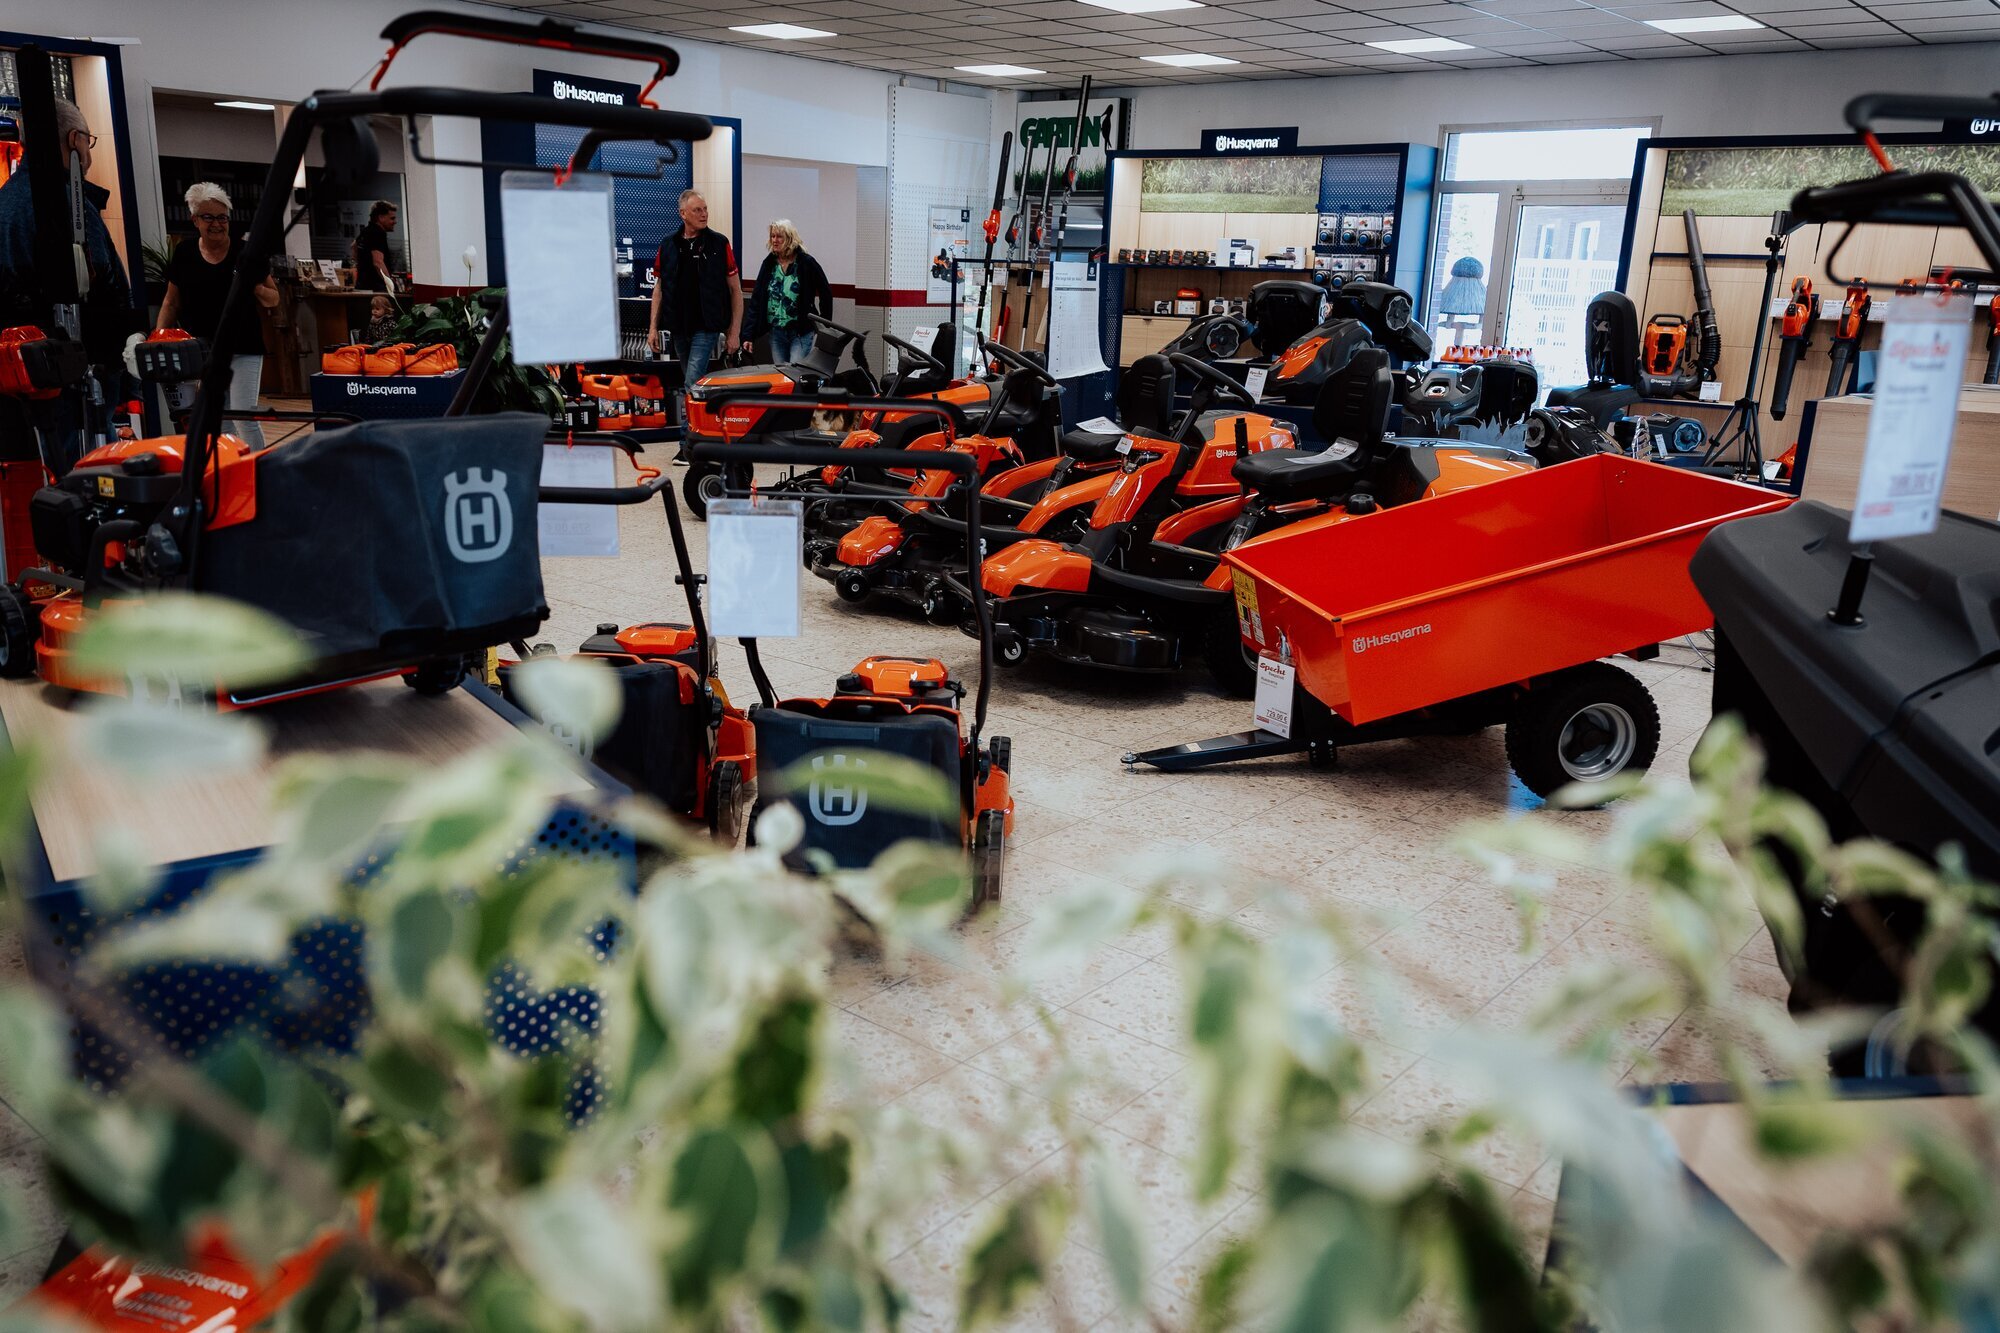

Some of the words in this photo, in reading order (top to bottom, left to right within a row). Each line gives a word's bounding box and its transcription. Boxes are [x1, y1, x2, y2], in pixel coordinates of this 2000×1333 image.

[566, 84, 623, 105] Husqvarna
[1226, 137, 1279, 150] Husqvarna
[360, 383, 417, 396] Husqvarna
[1366, 623, 1432, 649] Husqvarna
